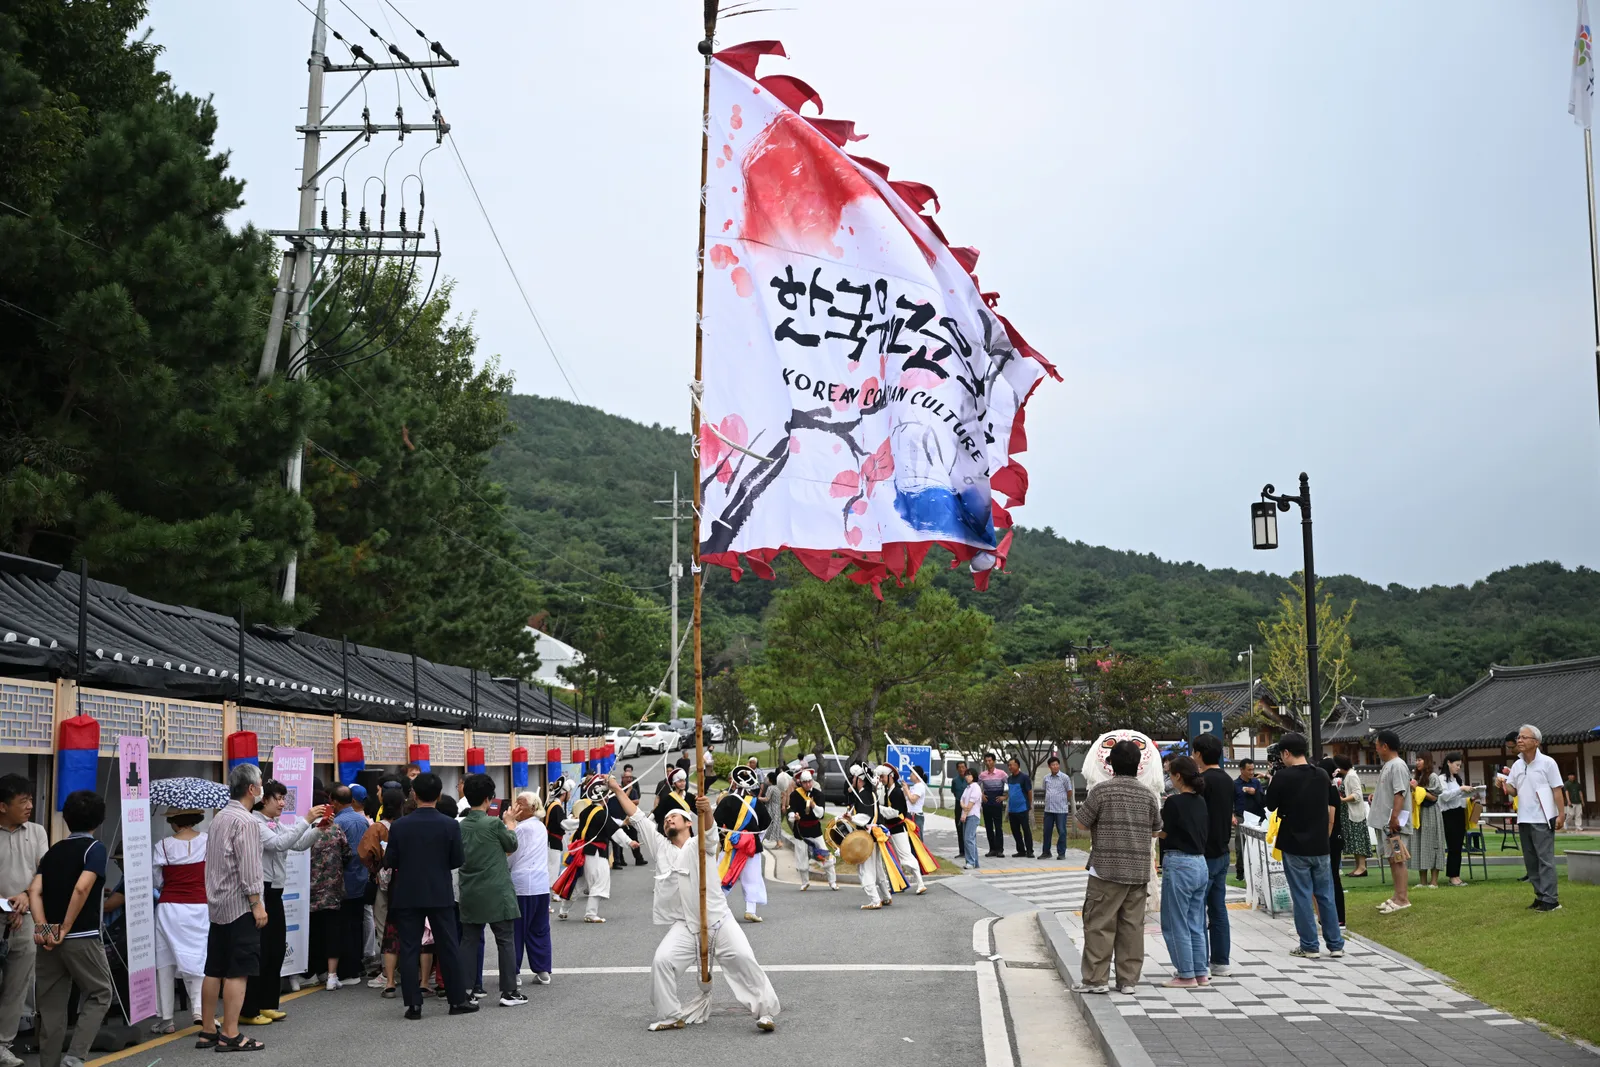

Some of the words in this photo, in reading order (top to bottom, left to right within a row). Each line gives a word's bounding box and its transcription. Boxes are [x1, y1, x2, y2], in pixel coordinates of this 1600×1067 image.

[782, 367, 860, 404] KOREAN
[910, 391, 984, 462] CULTURE
[1200, 720, 1213, 735] P
[277, 757, 307, 771] 선비회원
